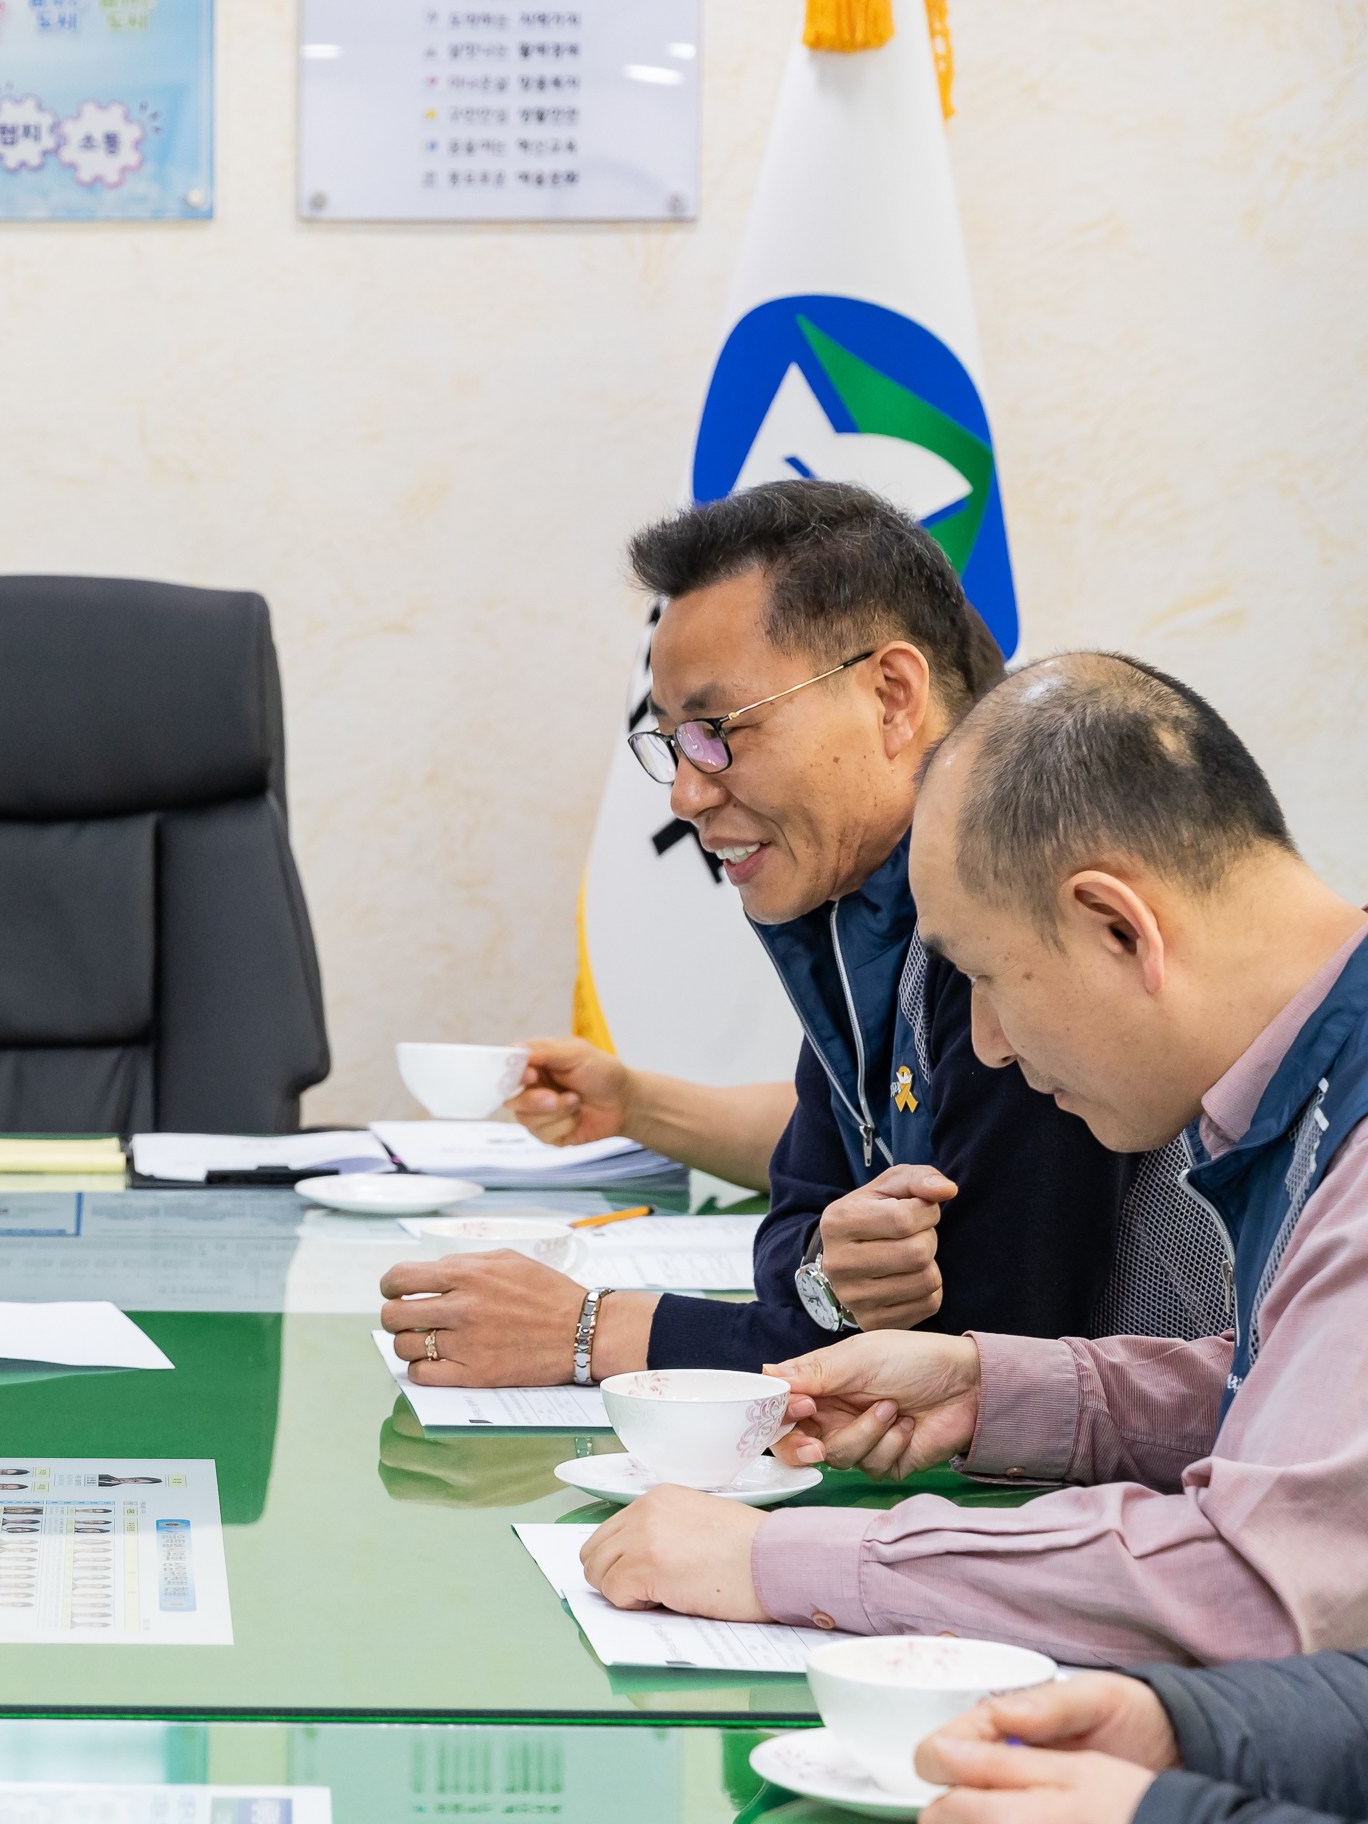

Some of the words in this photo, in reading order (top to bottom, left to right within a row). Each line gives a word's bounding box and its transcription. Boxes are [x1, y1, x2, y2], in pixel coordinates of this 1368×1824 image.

[36, 11, 78, 31] 도시
[106, 11, 149, 32] 도시
[78, 131, 121, 156] 소통
